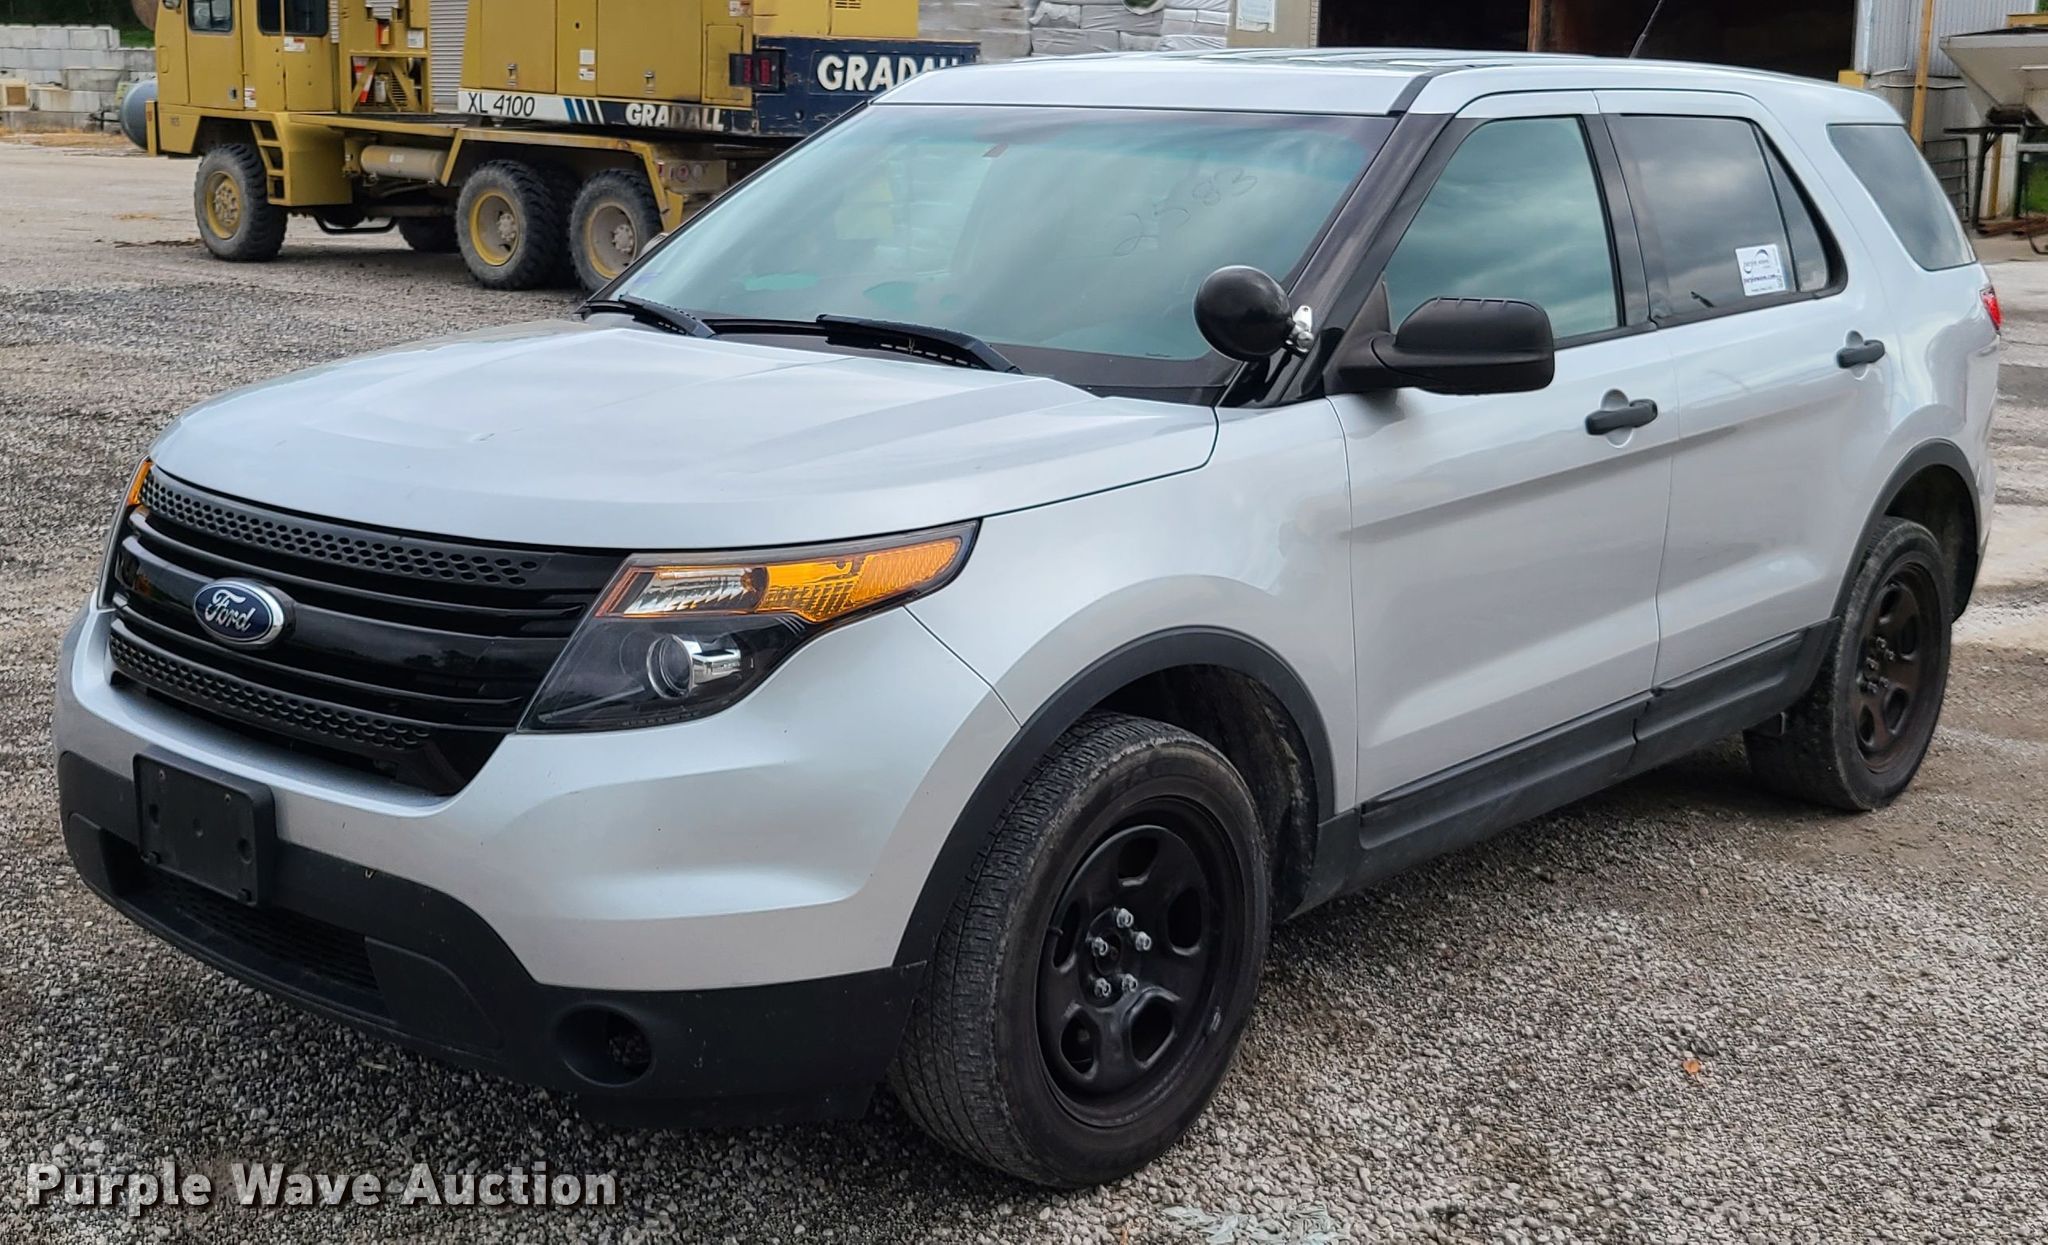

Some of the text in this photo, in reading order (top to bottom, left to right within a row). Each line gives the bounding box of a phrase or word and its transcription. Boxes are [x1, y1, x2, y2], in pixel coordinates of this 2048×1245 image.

[467, 92, 535, 117] XL 4100
[625, 102, 725, 131] GRADALL
[205, 589, 256, 632] Ford
